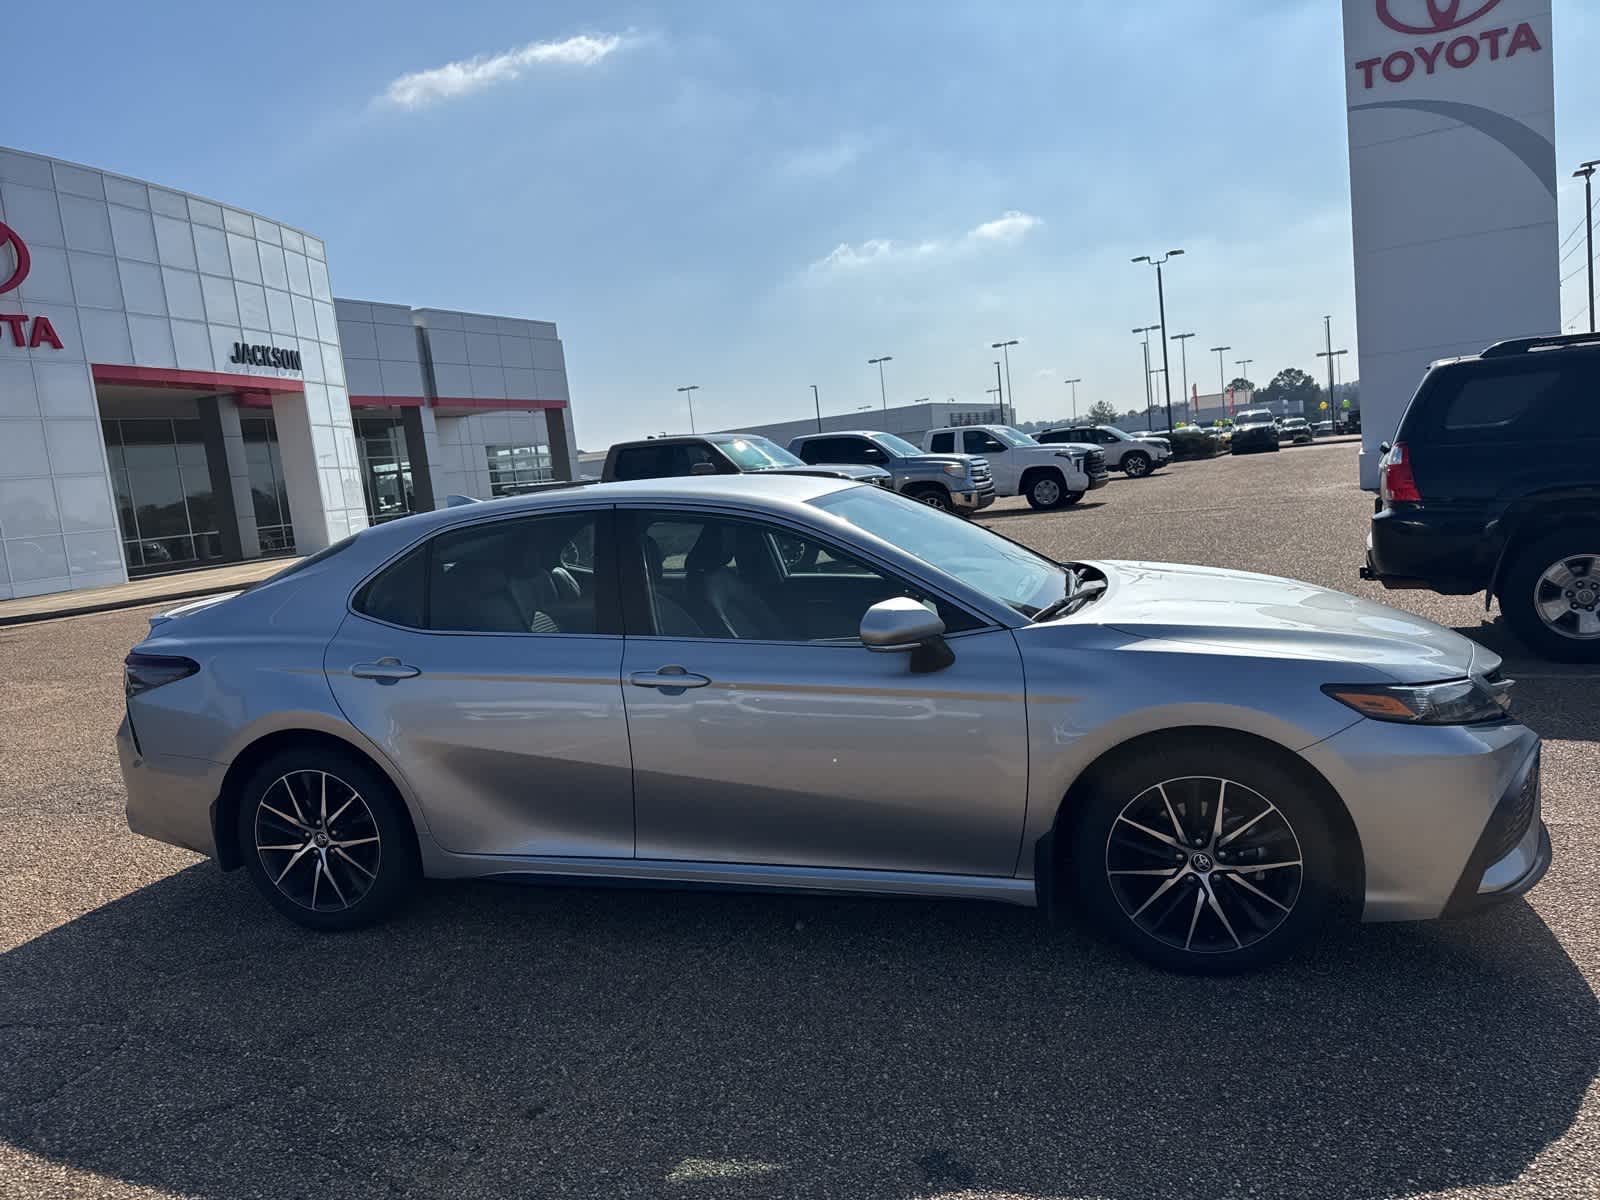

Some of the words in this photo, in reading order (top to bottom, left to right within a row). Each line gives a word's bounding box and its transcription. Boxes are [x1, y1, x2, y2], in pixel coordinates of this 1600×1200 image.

[1355, 22, 1542, 90] TOYOTA
[0, 314, 64, 350] TA
[230, 342, 303, 371] JACKSON
